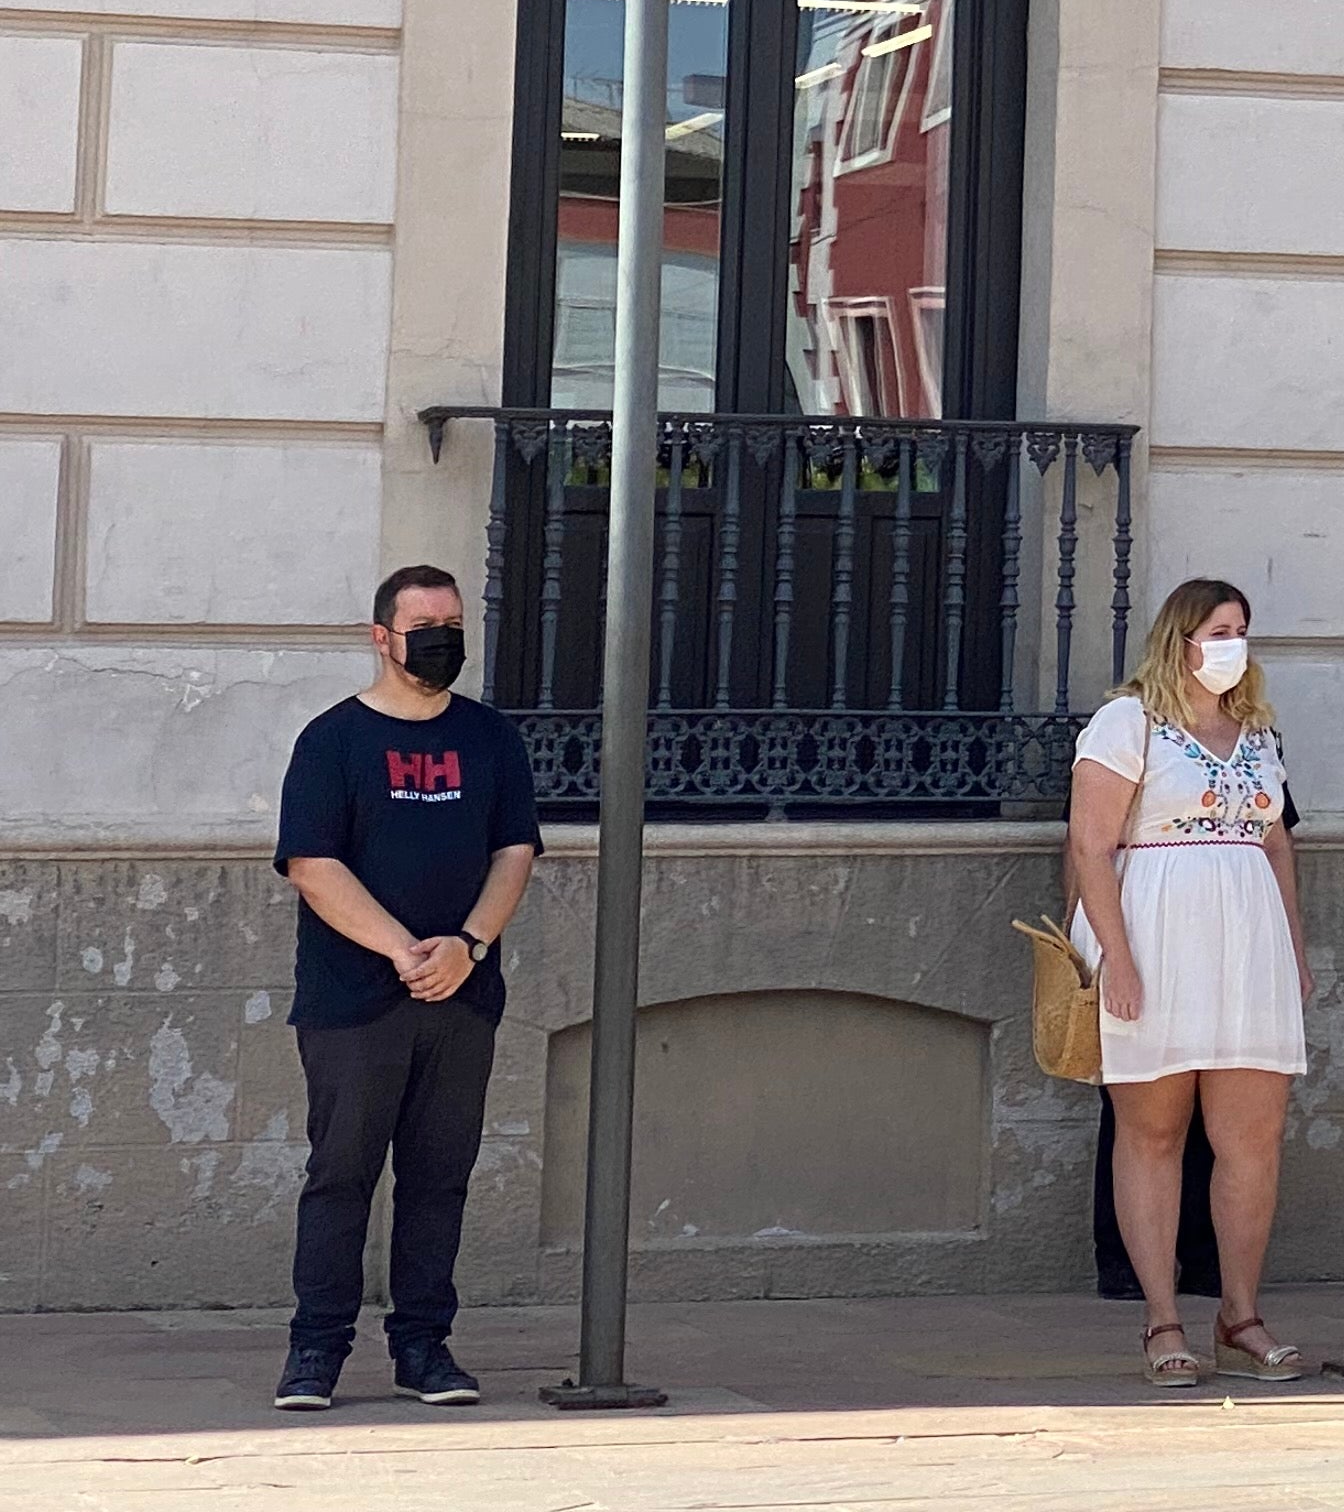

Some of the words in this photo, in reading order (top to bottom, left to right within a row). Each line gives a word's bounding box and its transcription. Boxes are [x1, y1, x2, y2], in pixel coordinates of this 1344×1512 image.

[387, 751, 461, 790] HH
[390, 789, 420, 800] HELLY
[421, 791, 461, 802] HANSEN
